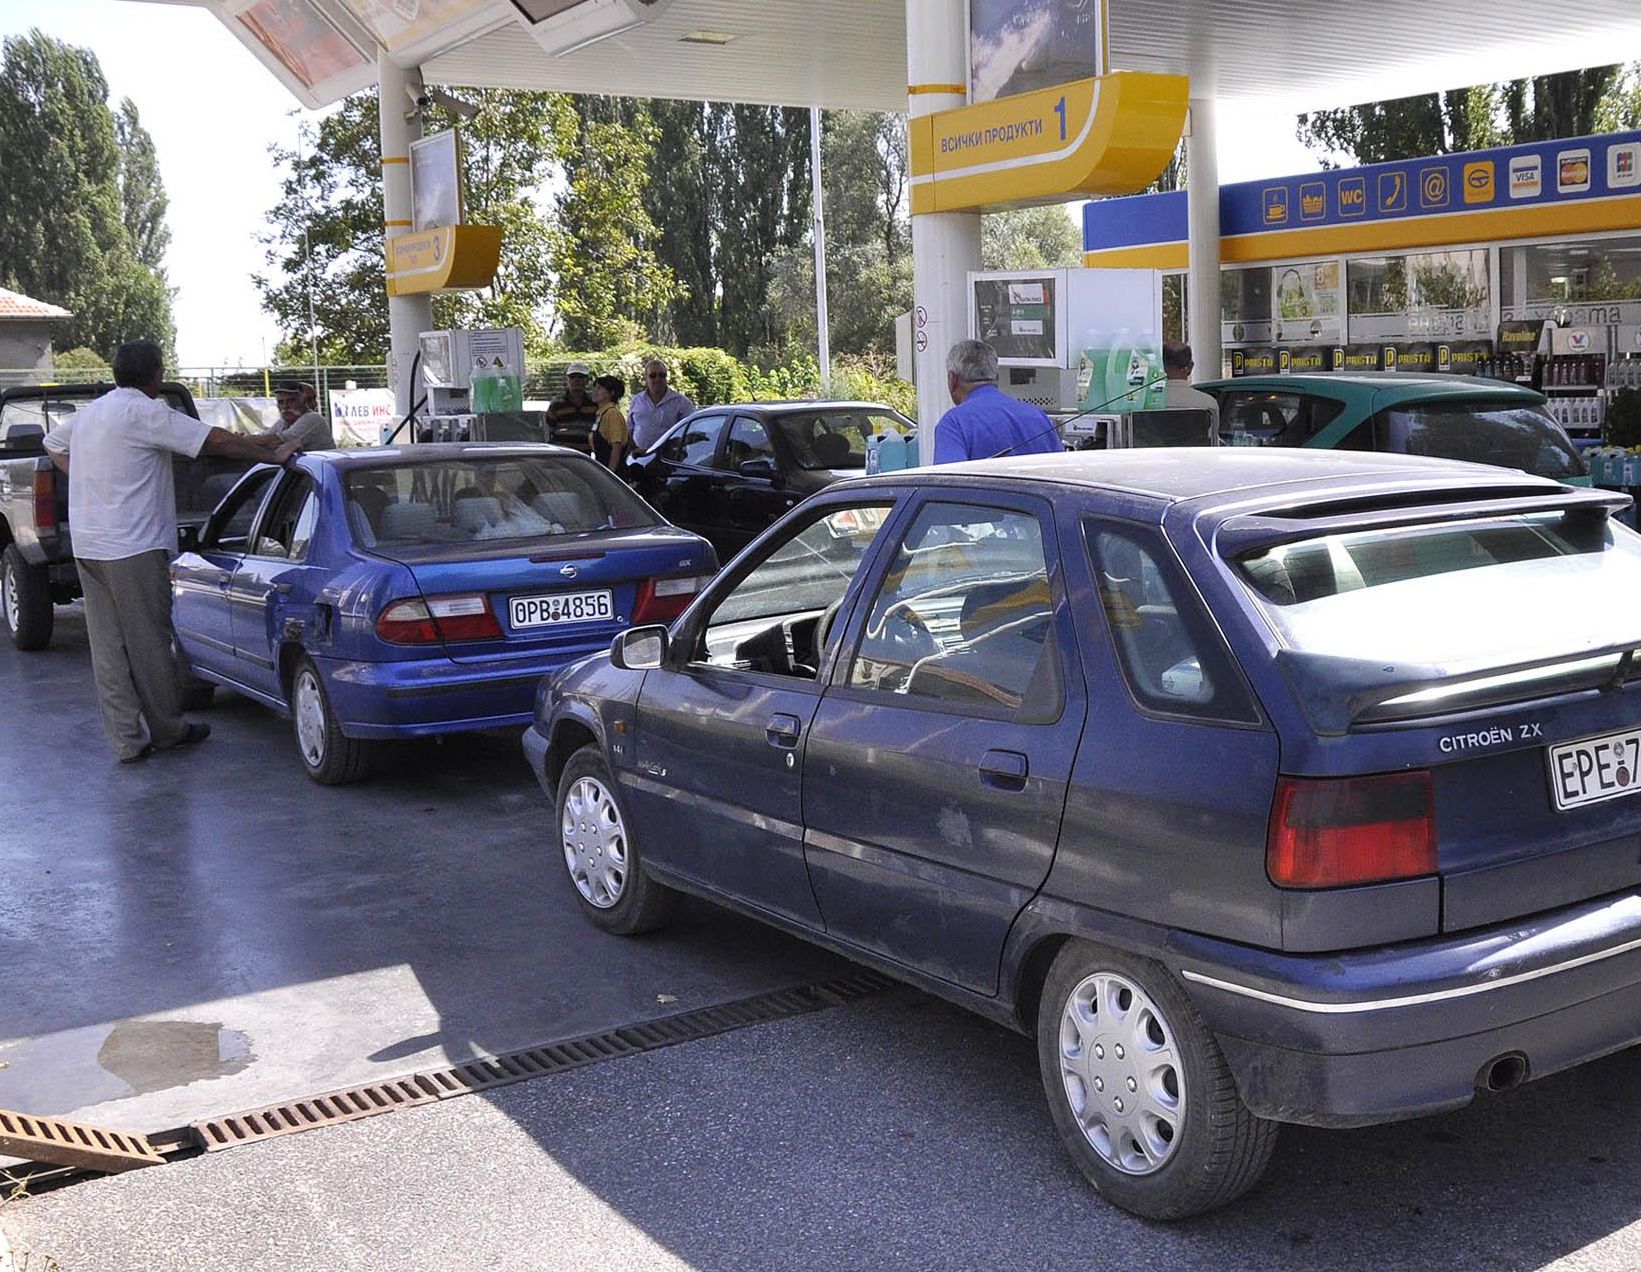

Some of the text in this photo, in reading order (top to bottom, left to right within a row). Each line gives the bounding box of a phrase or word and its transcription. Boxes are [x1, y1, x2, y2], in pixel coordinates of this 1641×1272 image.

[1053, 96, 1067, 141] 1
[941, 118, 1043, 153] ВСИЧКИ ПРОДУКТИ
[1516, 171, 1536, 182] VISA
[1341, 188, 1363, 205] WC
[433, 235, 441, 260] 3
[351, 404, 391, 417] ЛЕВ ИНС
[1439, 723, 1543, 752] CITROËN ZX
